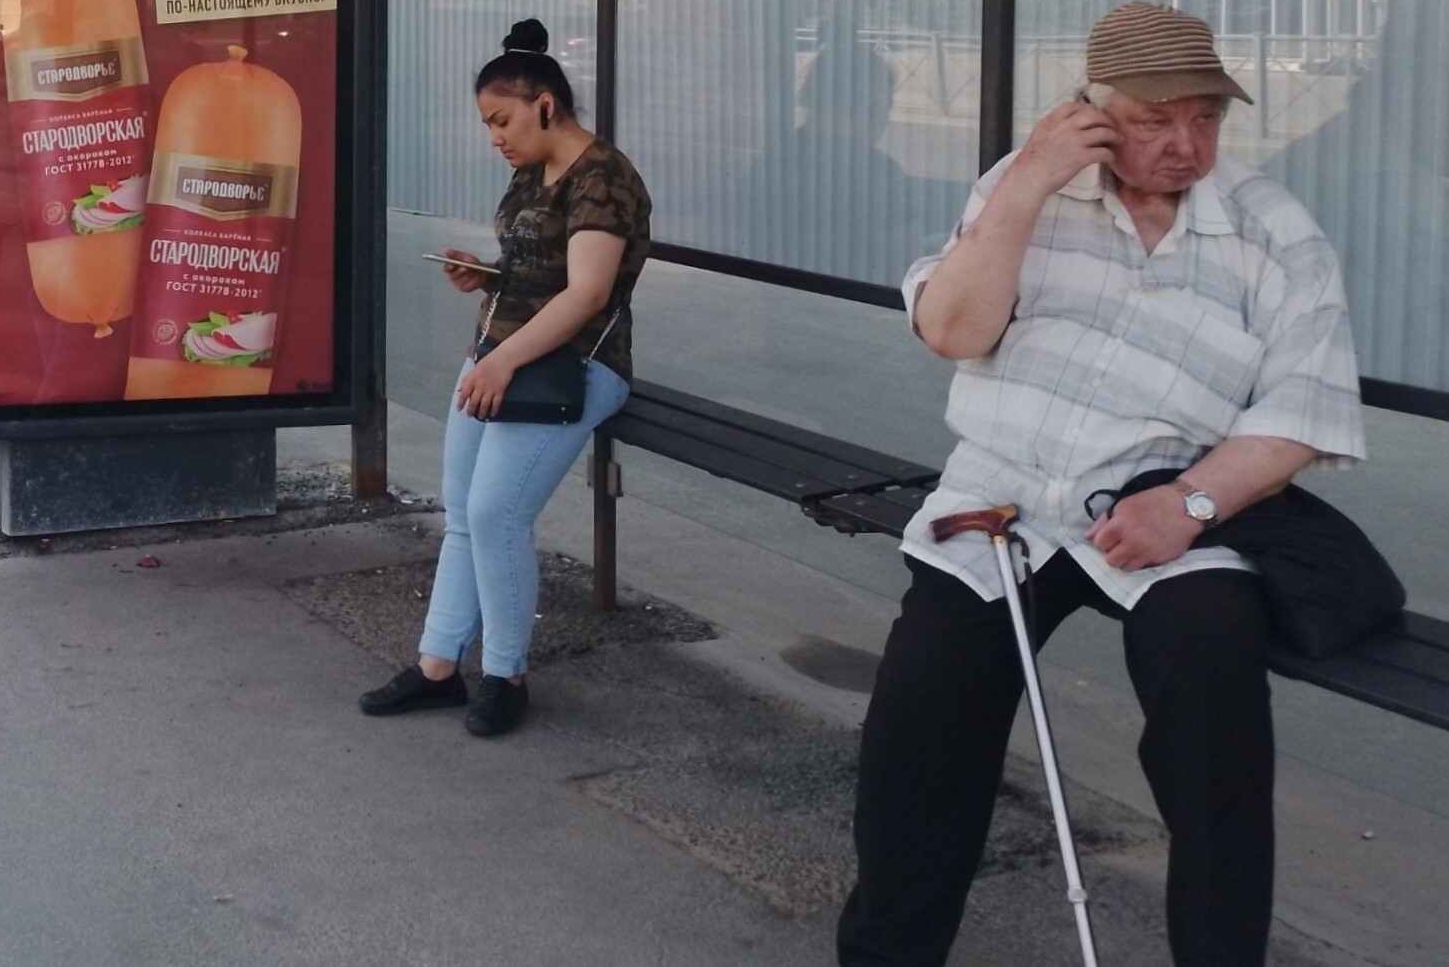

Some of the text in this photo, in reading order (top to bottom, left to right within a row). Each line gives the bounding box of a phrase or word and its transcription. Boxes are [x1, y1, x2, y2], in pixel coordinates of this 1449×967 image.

[22, 116, 145, 155] СТАРОДВОРСКАЯ
[44, 163, 73, 176] ГОСТ
[149, 238, 281, 275] СТАРОДВОРСКАЯ
[166, 280, 197, 293] ГОСТ
